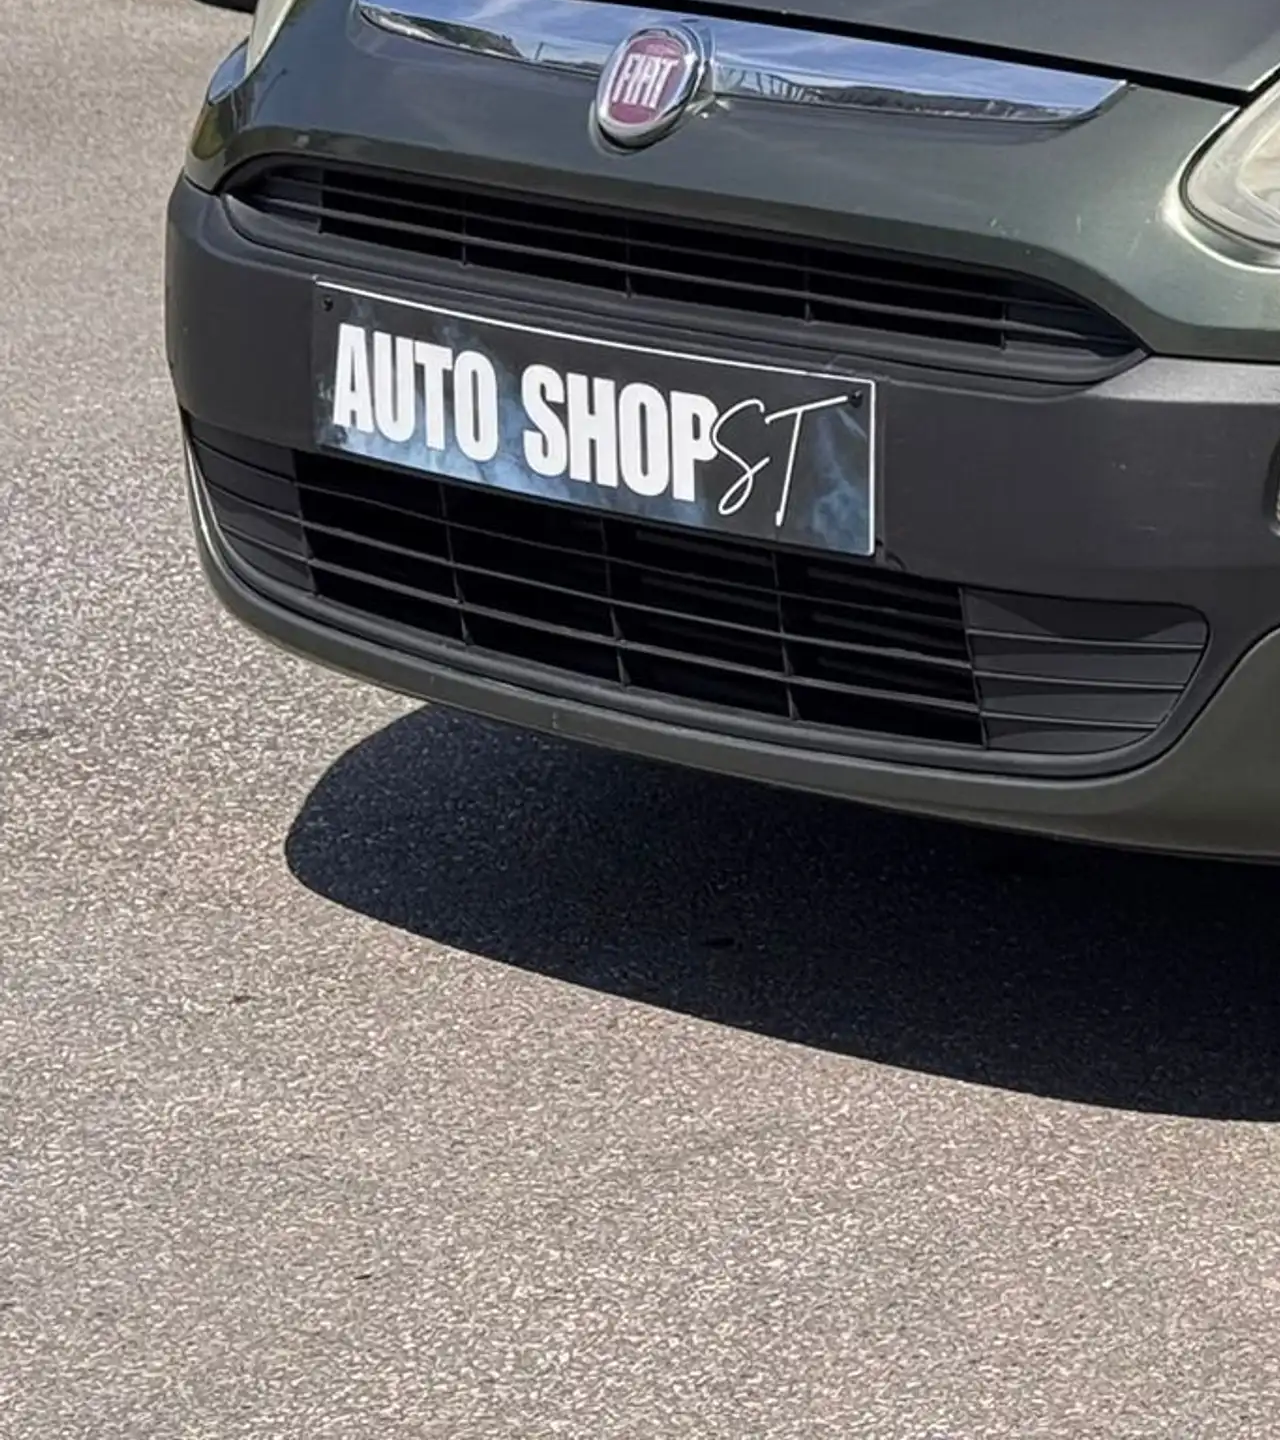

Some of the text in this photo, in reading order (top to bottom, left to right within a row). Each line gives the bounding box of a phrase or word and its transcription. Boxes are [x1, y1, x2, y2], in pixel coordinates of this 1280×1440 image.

[613, 53, 680, 109] FIAT
[333, 323, 499, 461] AUTO
[521, 364, 718, 501] SHOP
